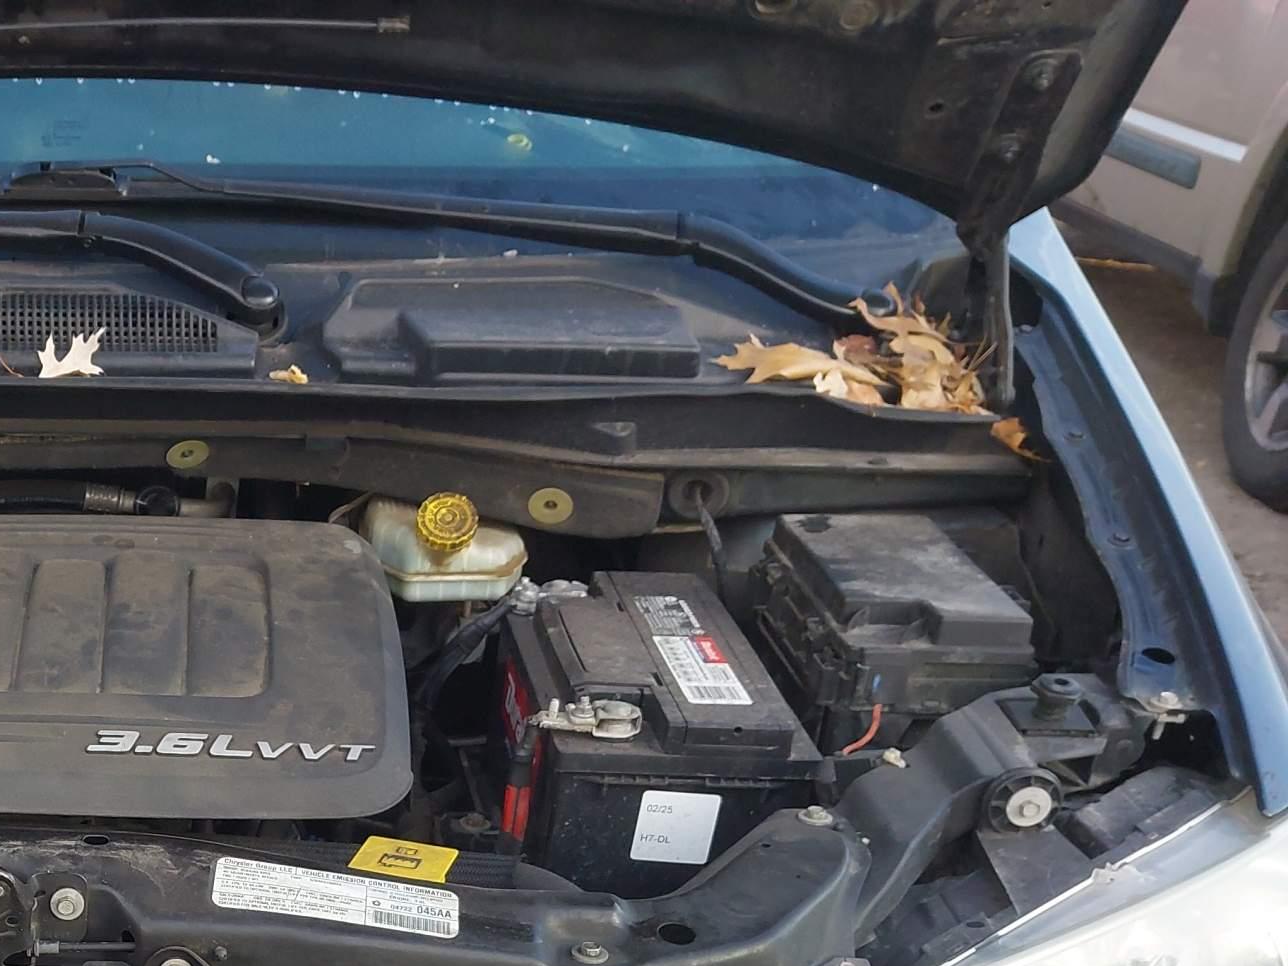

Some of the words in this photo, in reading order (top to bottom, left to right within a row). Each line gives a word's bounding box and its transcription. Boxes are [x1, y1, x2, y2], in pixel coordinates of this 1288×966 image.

[86, 729, 253, 758] 3.6L
[257, 740, 376, 761] VVT
[646, 804, 673, 814] 02/25
[639, 833, 672, 844] H7-DL
[224, 858, 253, 868] Chrysler
[255, 862, 277, 872] Group
[301, 869, 330, 879] VEHICLE
[332, 875, 367, 886] EMISSION
[368, 881, 401, 890] CONTROL
[403, 886, 453, 898] INFORMATION
[416, 905, 452, 919] 045AA
